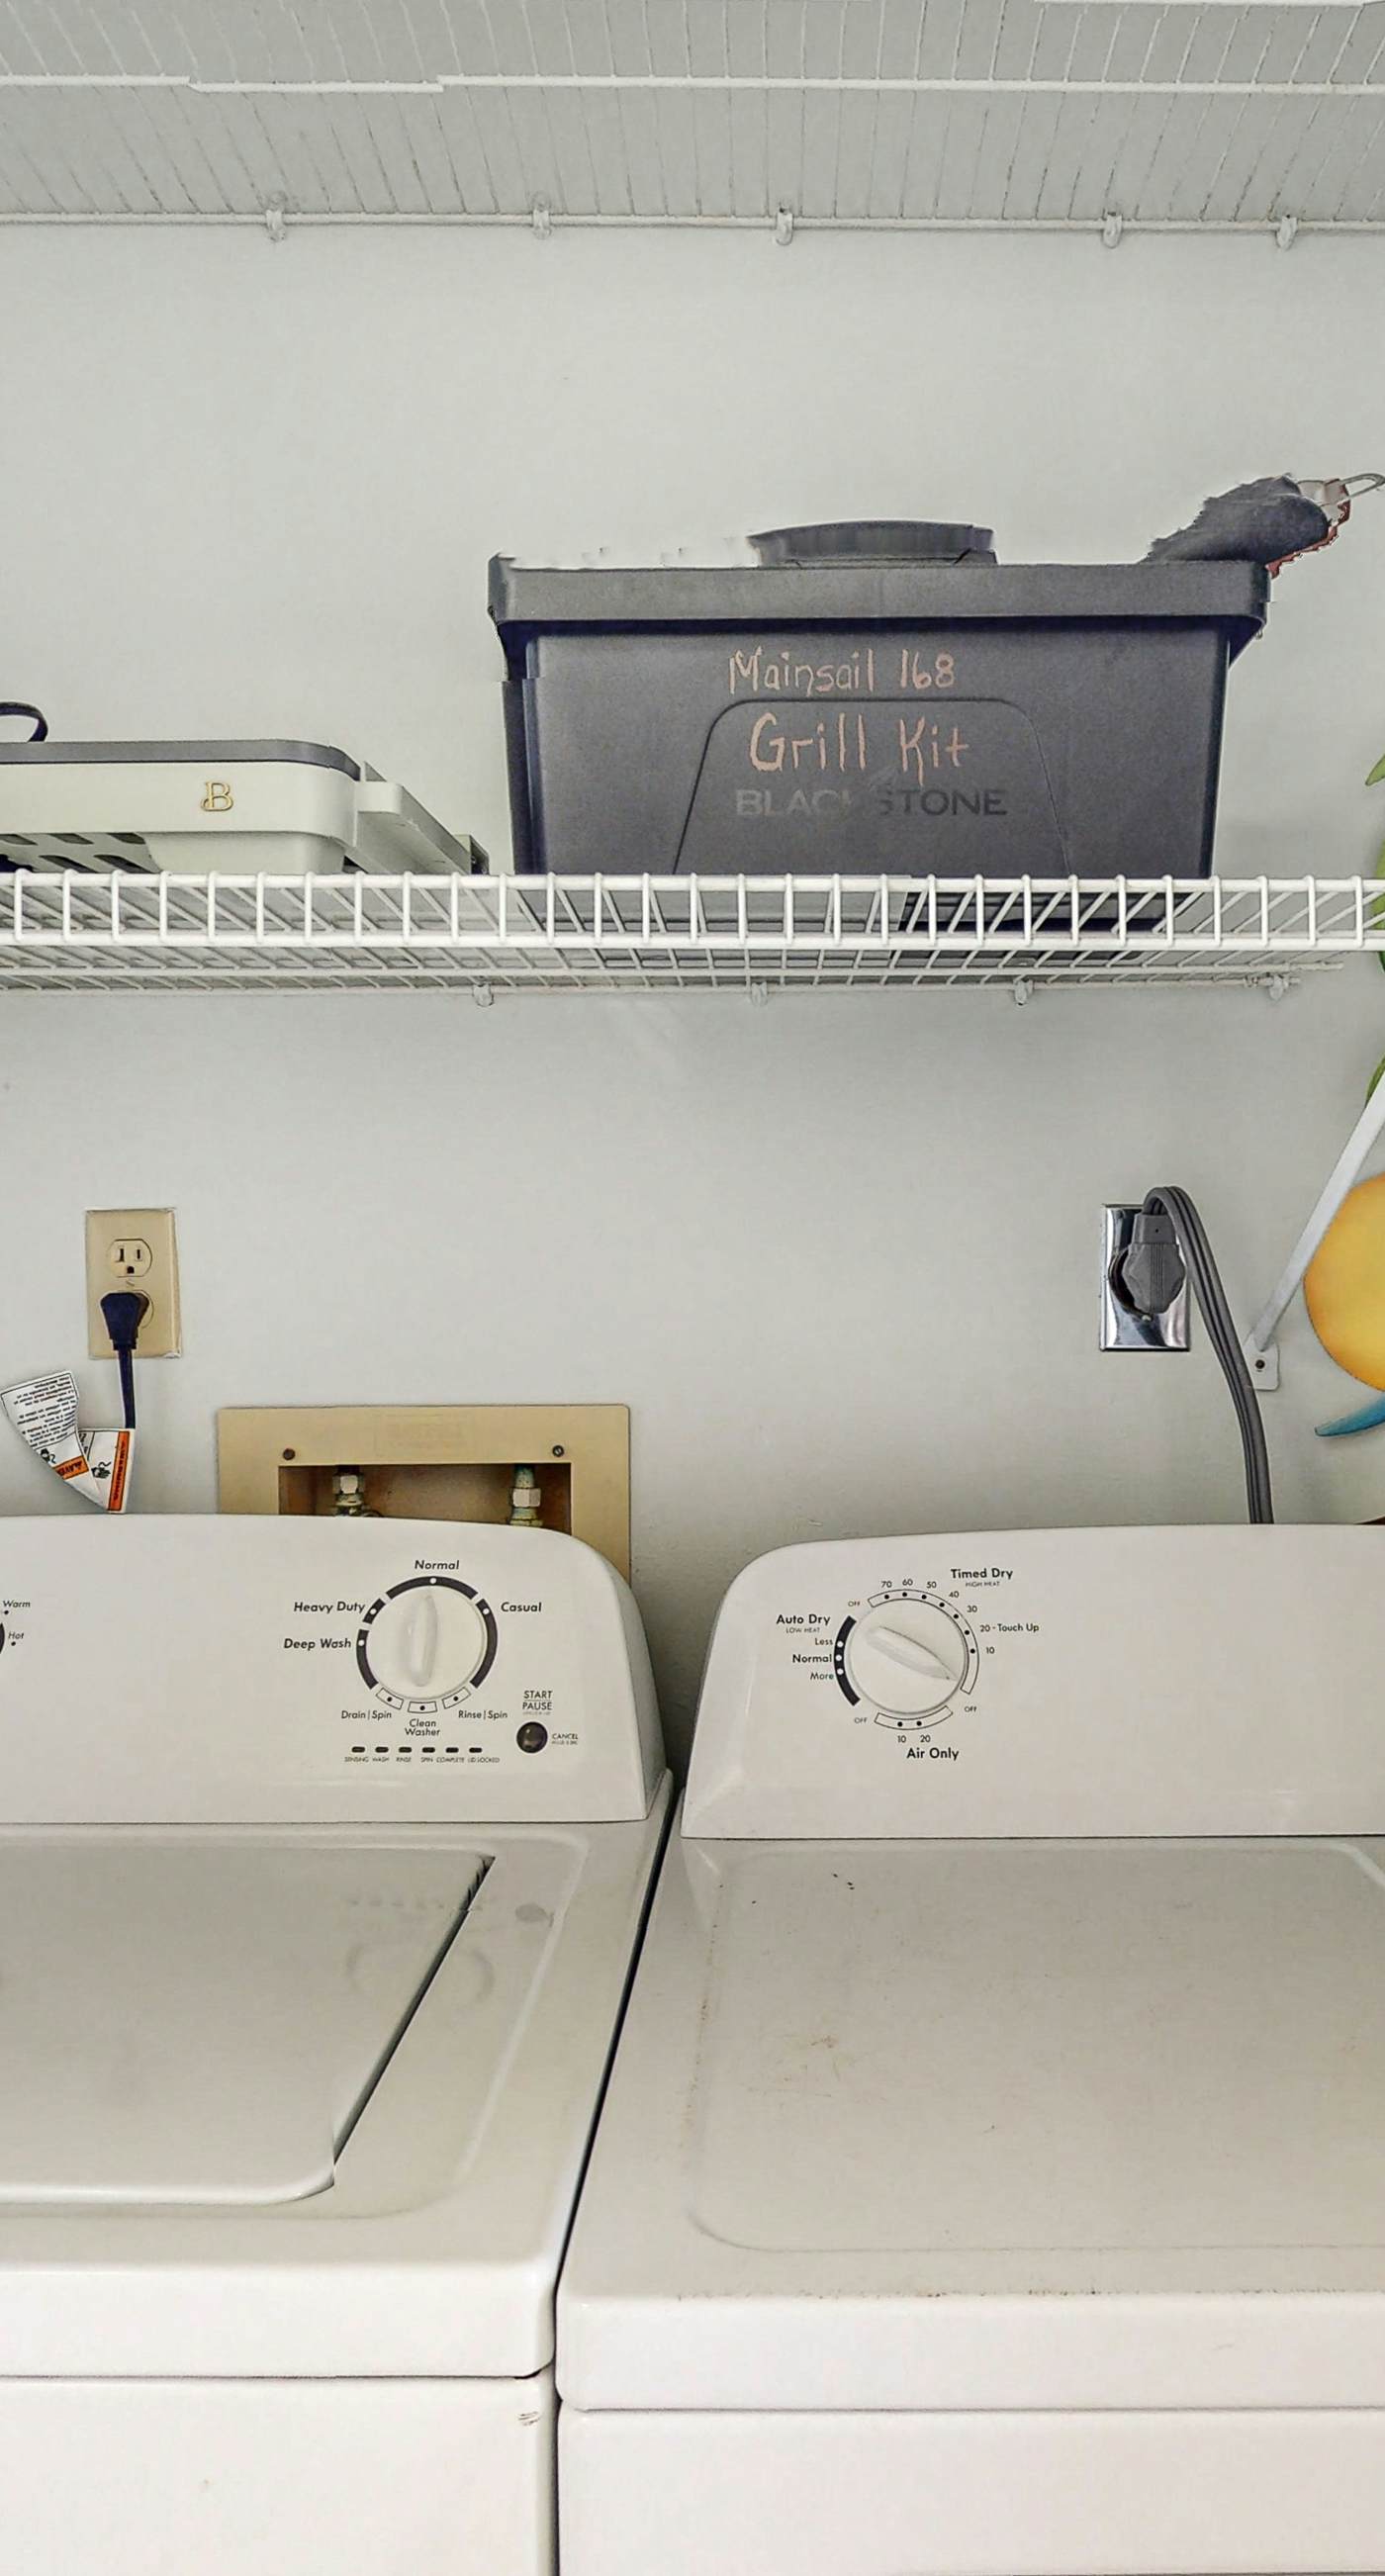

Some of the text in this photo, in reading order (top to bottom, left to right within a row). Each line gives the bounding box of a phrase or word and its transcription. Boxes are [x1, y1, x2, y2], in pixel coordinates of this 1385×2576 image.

[729, 646, 956, 696] Mainsail 168
[749, 712, 970, 787] Grill Kit
[415, 1560, 460, 1571] Normal
[951, 1568, 1014, 1580] Timed Dry
[294, 1601, 366, 1613] Heavy Duty
[501, 1602, 542, 1612] Casual
[776, 1613, 831, 1625] Auto Dry
[1026, 1623, 1040, 1632] Up
[283, 1638, 351, 1651] Deep Wash
[814, 1637, 833, 1646] Less
[792, 1654, 833, 1663] Normal
[523, 1690, 552, 1700] START
[522, 1702, 552, 1710] PAUSE
[409, 1718, 436, 1727] Clean
[405, 1728, 440, 1737] Washer
[920, 1734, 931, 1743] 20
[906, 1747, 960, 1761] Air Only
